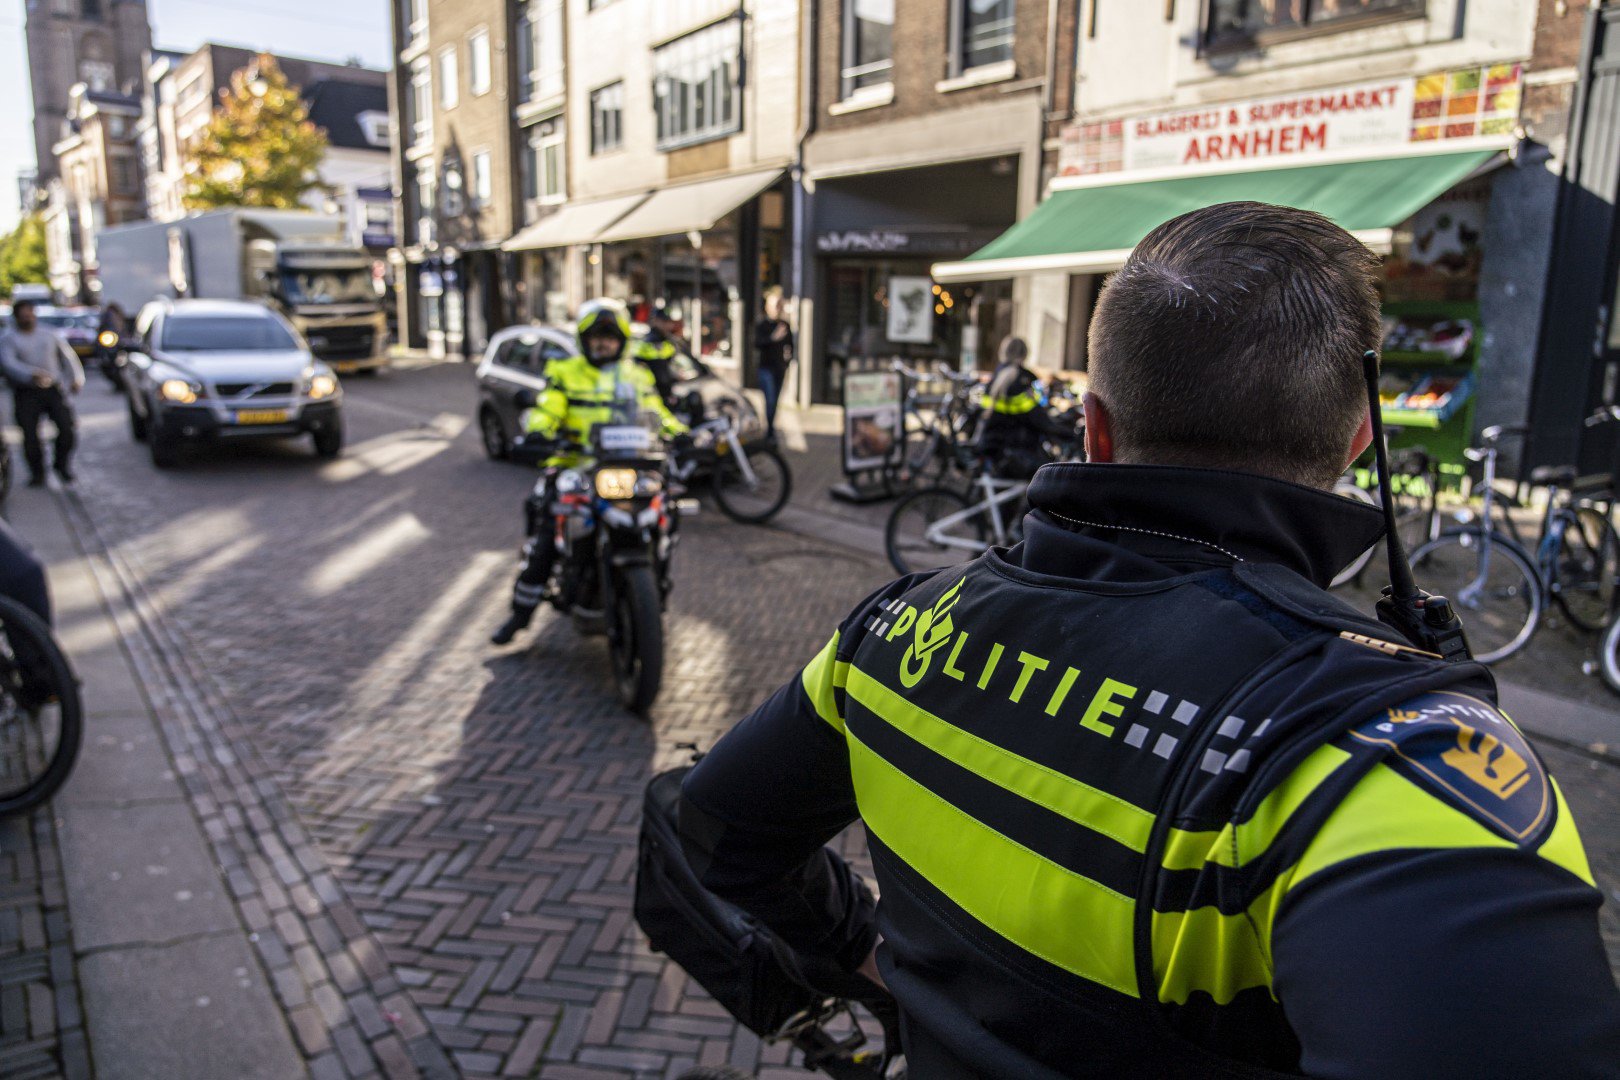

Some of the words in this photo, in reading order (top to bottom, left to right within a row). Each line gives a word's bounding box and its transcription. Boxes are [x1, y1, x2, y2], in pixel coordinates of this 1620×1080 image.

[1228, 108, 1239, 126] &
[1249, 85, 1399, 121] SUPERMARKT
[1183, 122, 1328, 165] ARNHEM
[885, 597, 1138, 738] POLITIE
